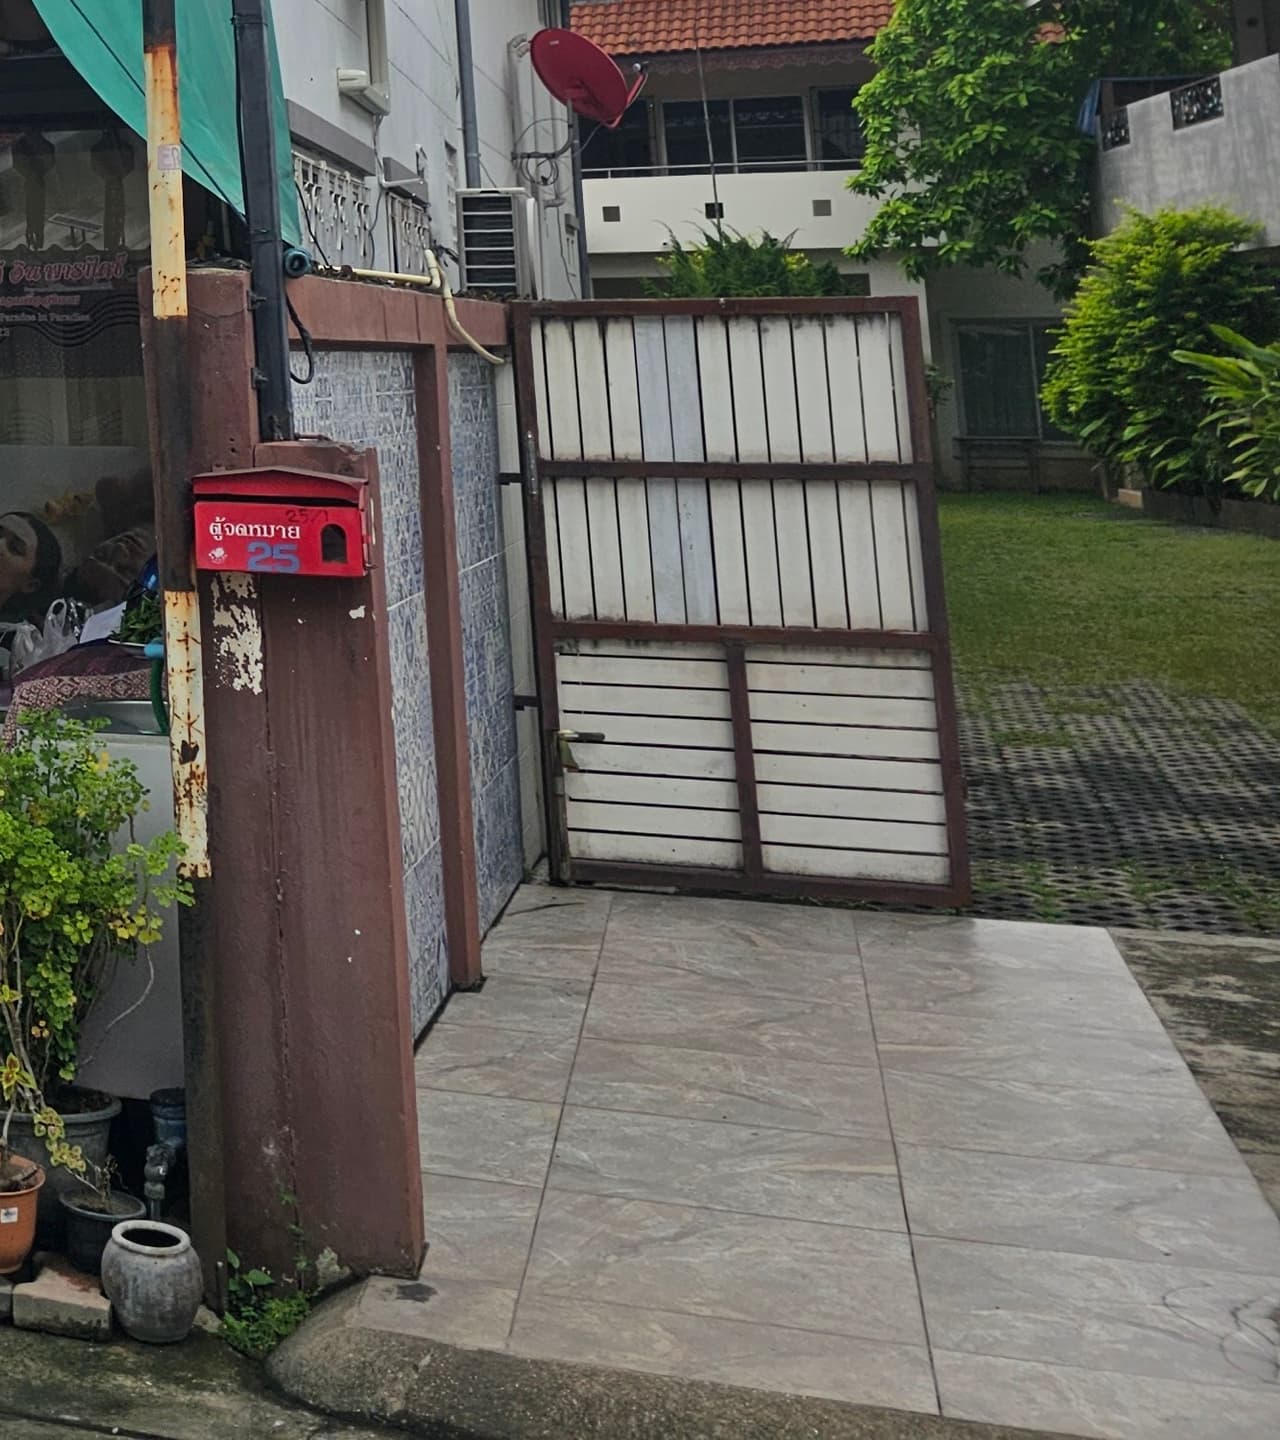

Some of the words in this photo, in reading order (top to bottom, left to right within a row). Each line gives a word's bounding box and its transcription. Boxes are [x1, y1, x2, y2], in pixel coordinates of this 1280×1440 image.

[209, 516, 300, 541] ตู้จดหมาย
[247, 540, 301, 573] 25
